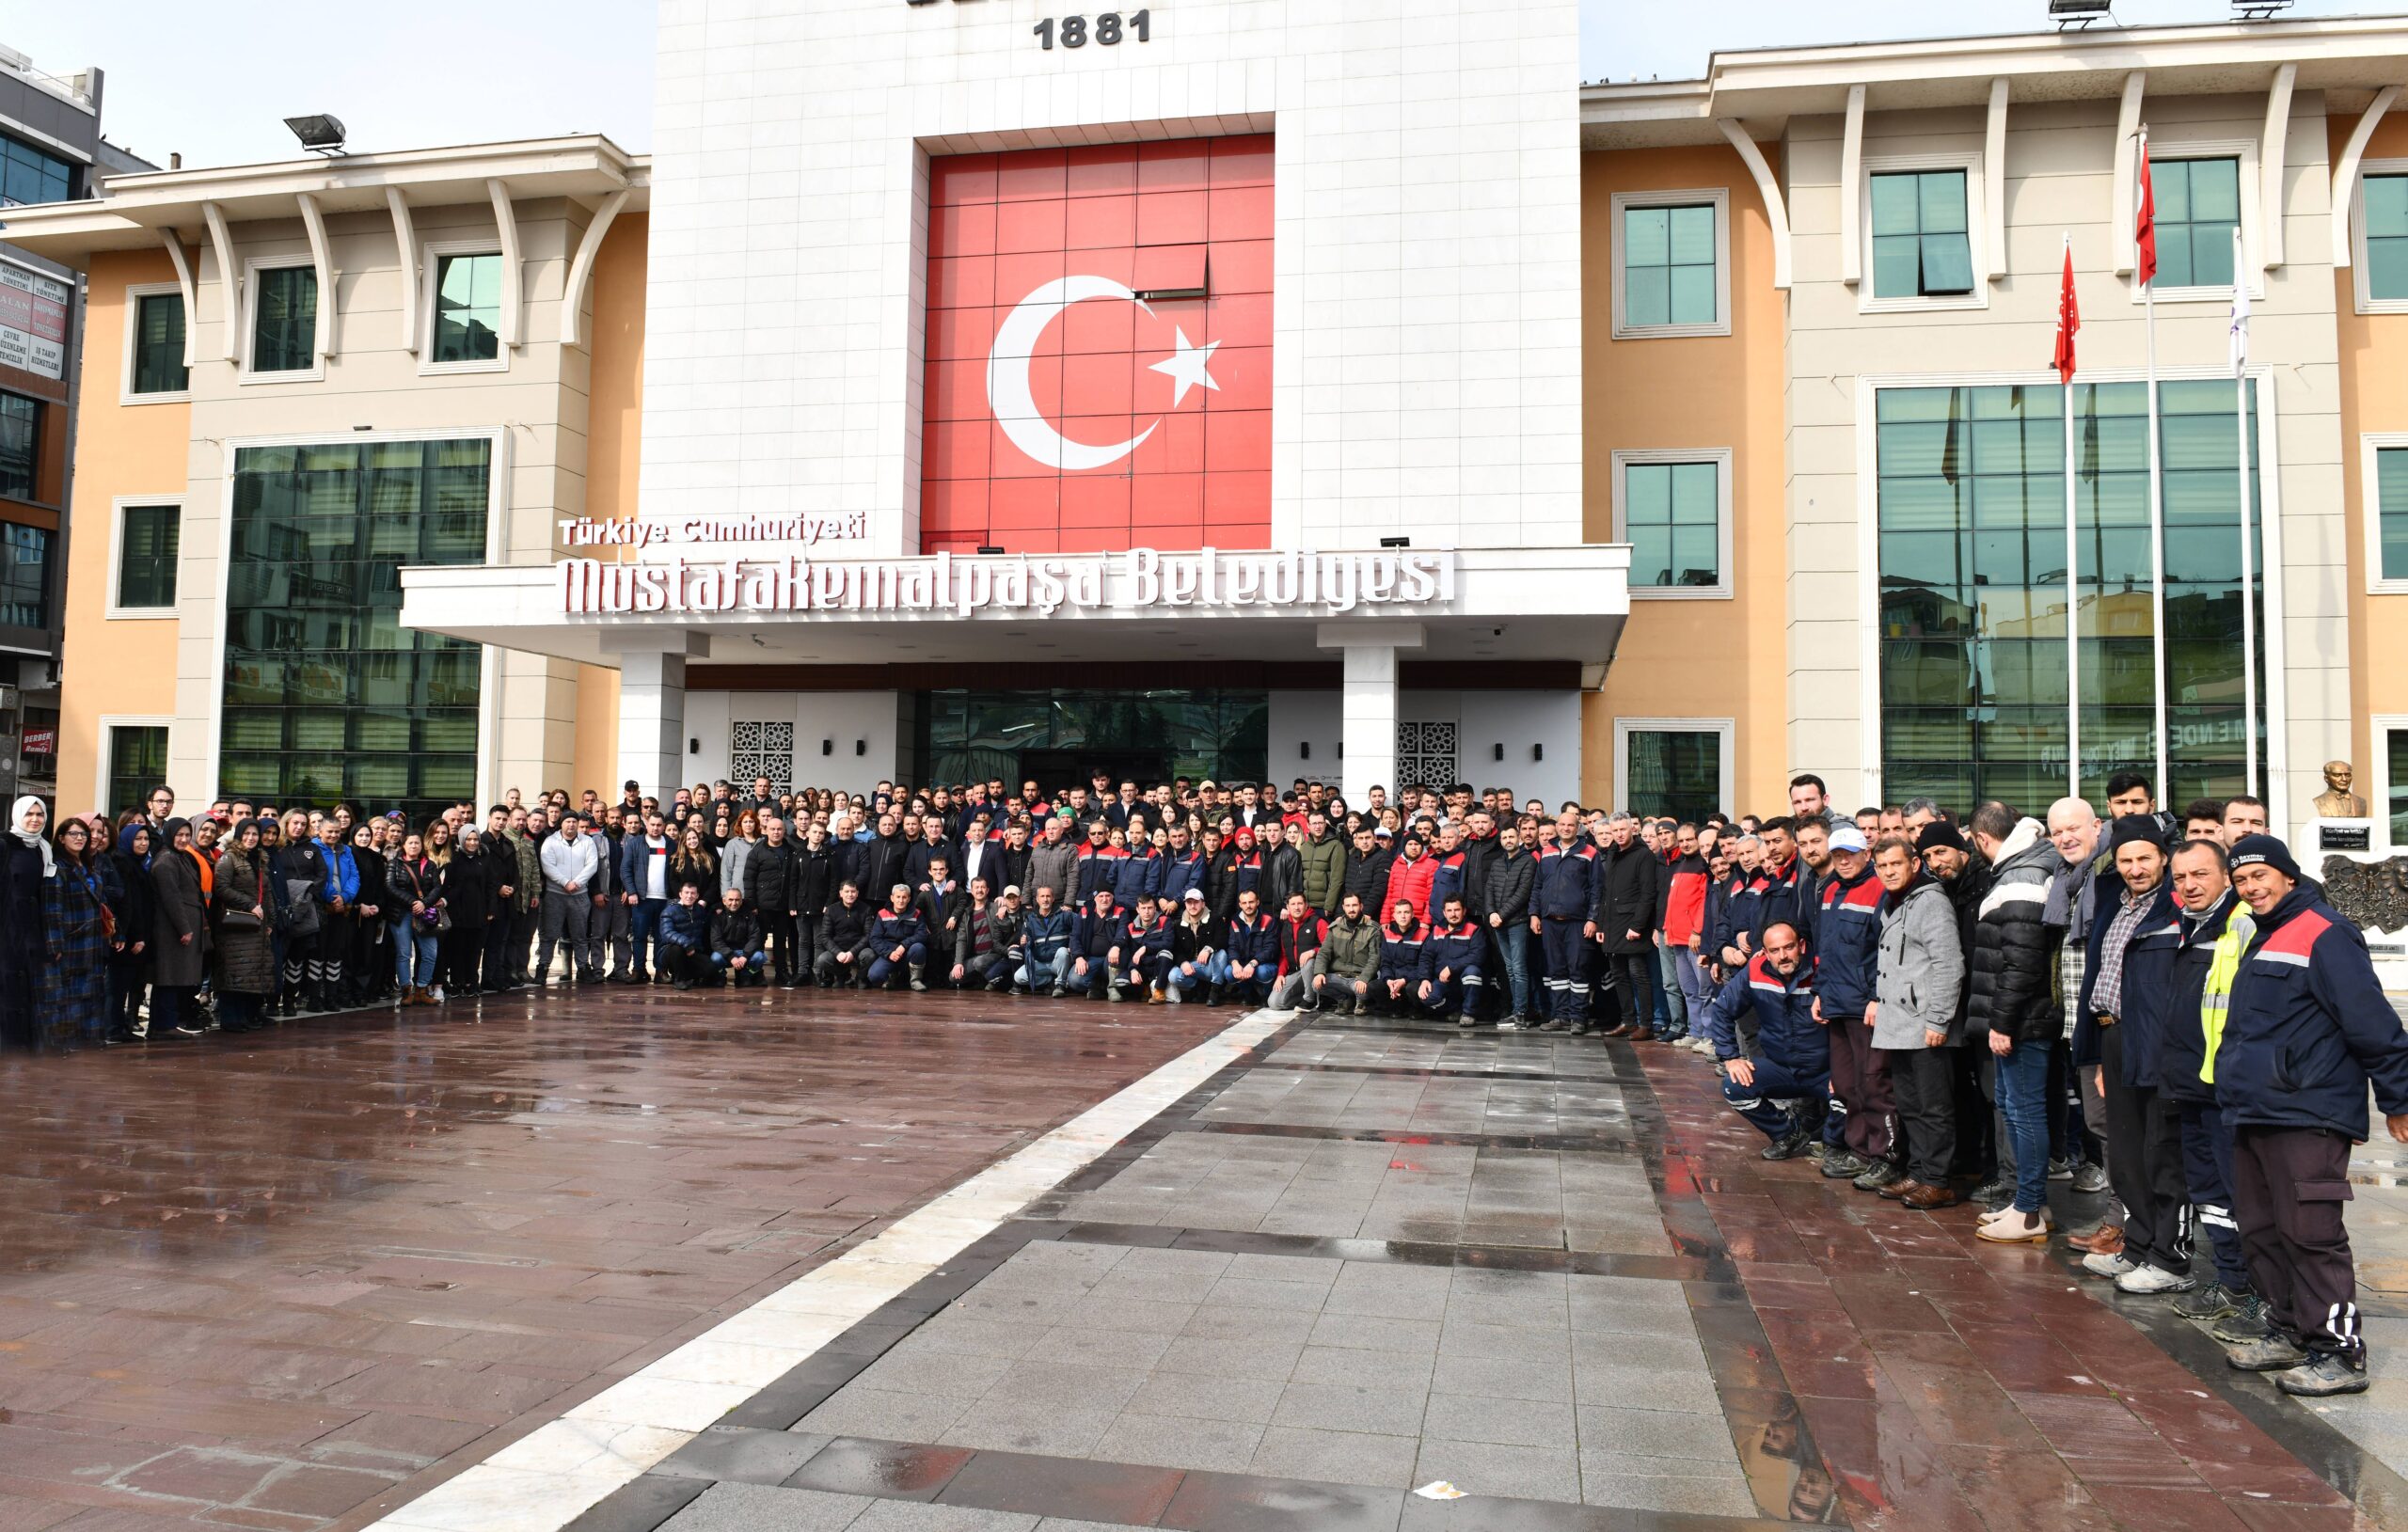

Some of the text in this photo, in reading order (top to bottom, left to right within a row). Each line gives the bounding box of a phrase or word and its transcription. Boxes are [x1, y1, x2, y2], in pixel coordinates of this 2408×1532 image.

[1034, 9, 1149, 50] 1881
[2, 267, 30, 281] APARTMAN
[0, 339, 26, 355] ÜZENLEME
[559, 512, 865, 548] Türkiye Cumhuriyeti
[557, 544, 1455, 616] Mustafakemalpaşa Belediyesi
[24, 732, 52, 744] BERBER
